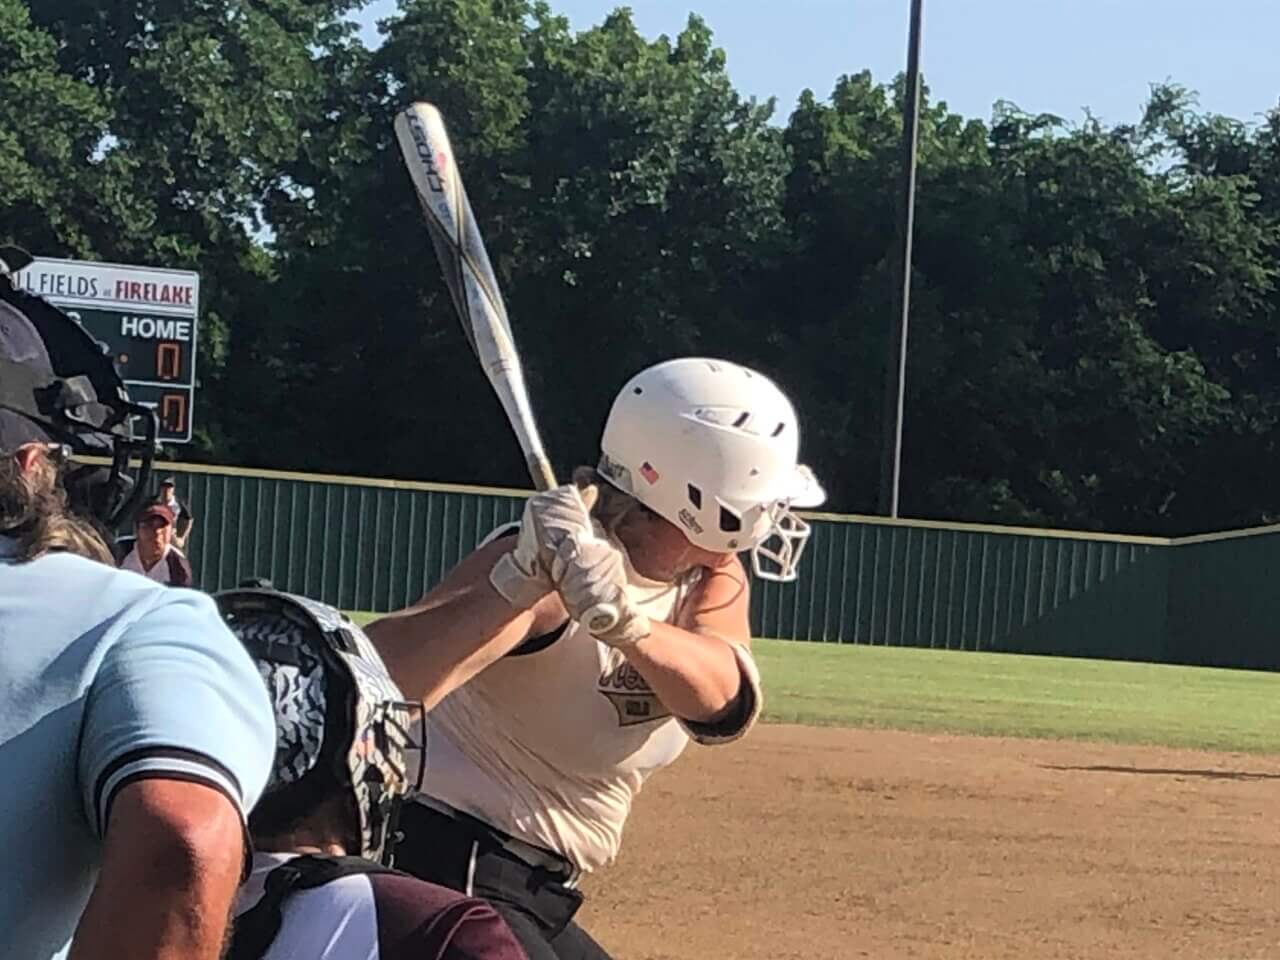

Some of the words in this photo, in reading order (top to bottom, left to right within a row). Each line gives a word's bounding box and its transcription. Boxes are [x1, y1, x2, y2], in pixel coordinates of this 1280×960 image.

[40, 273, 98, 298] FIELDS
[115, 280, 193, 305] FIRELAKE
[121, 316, 191, 341] HOME
